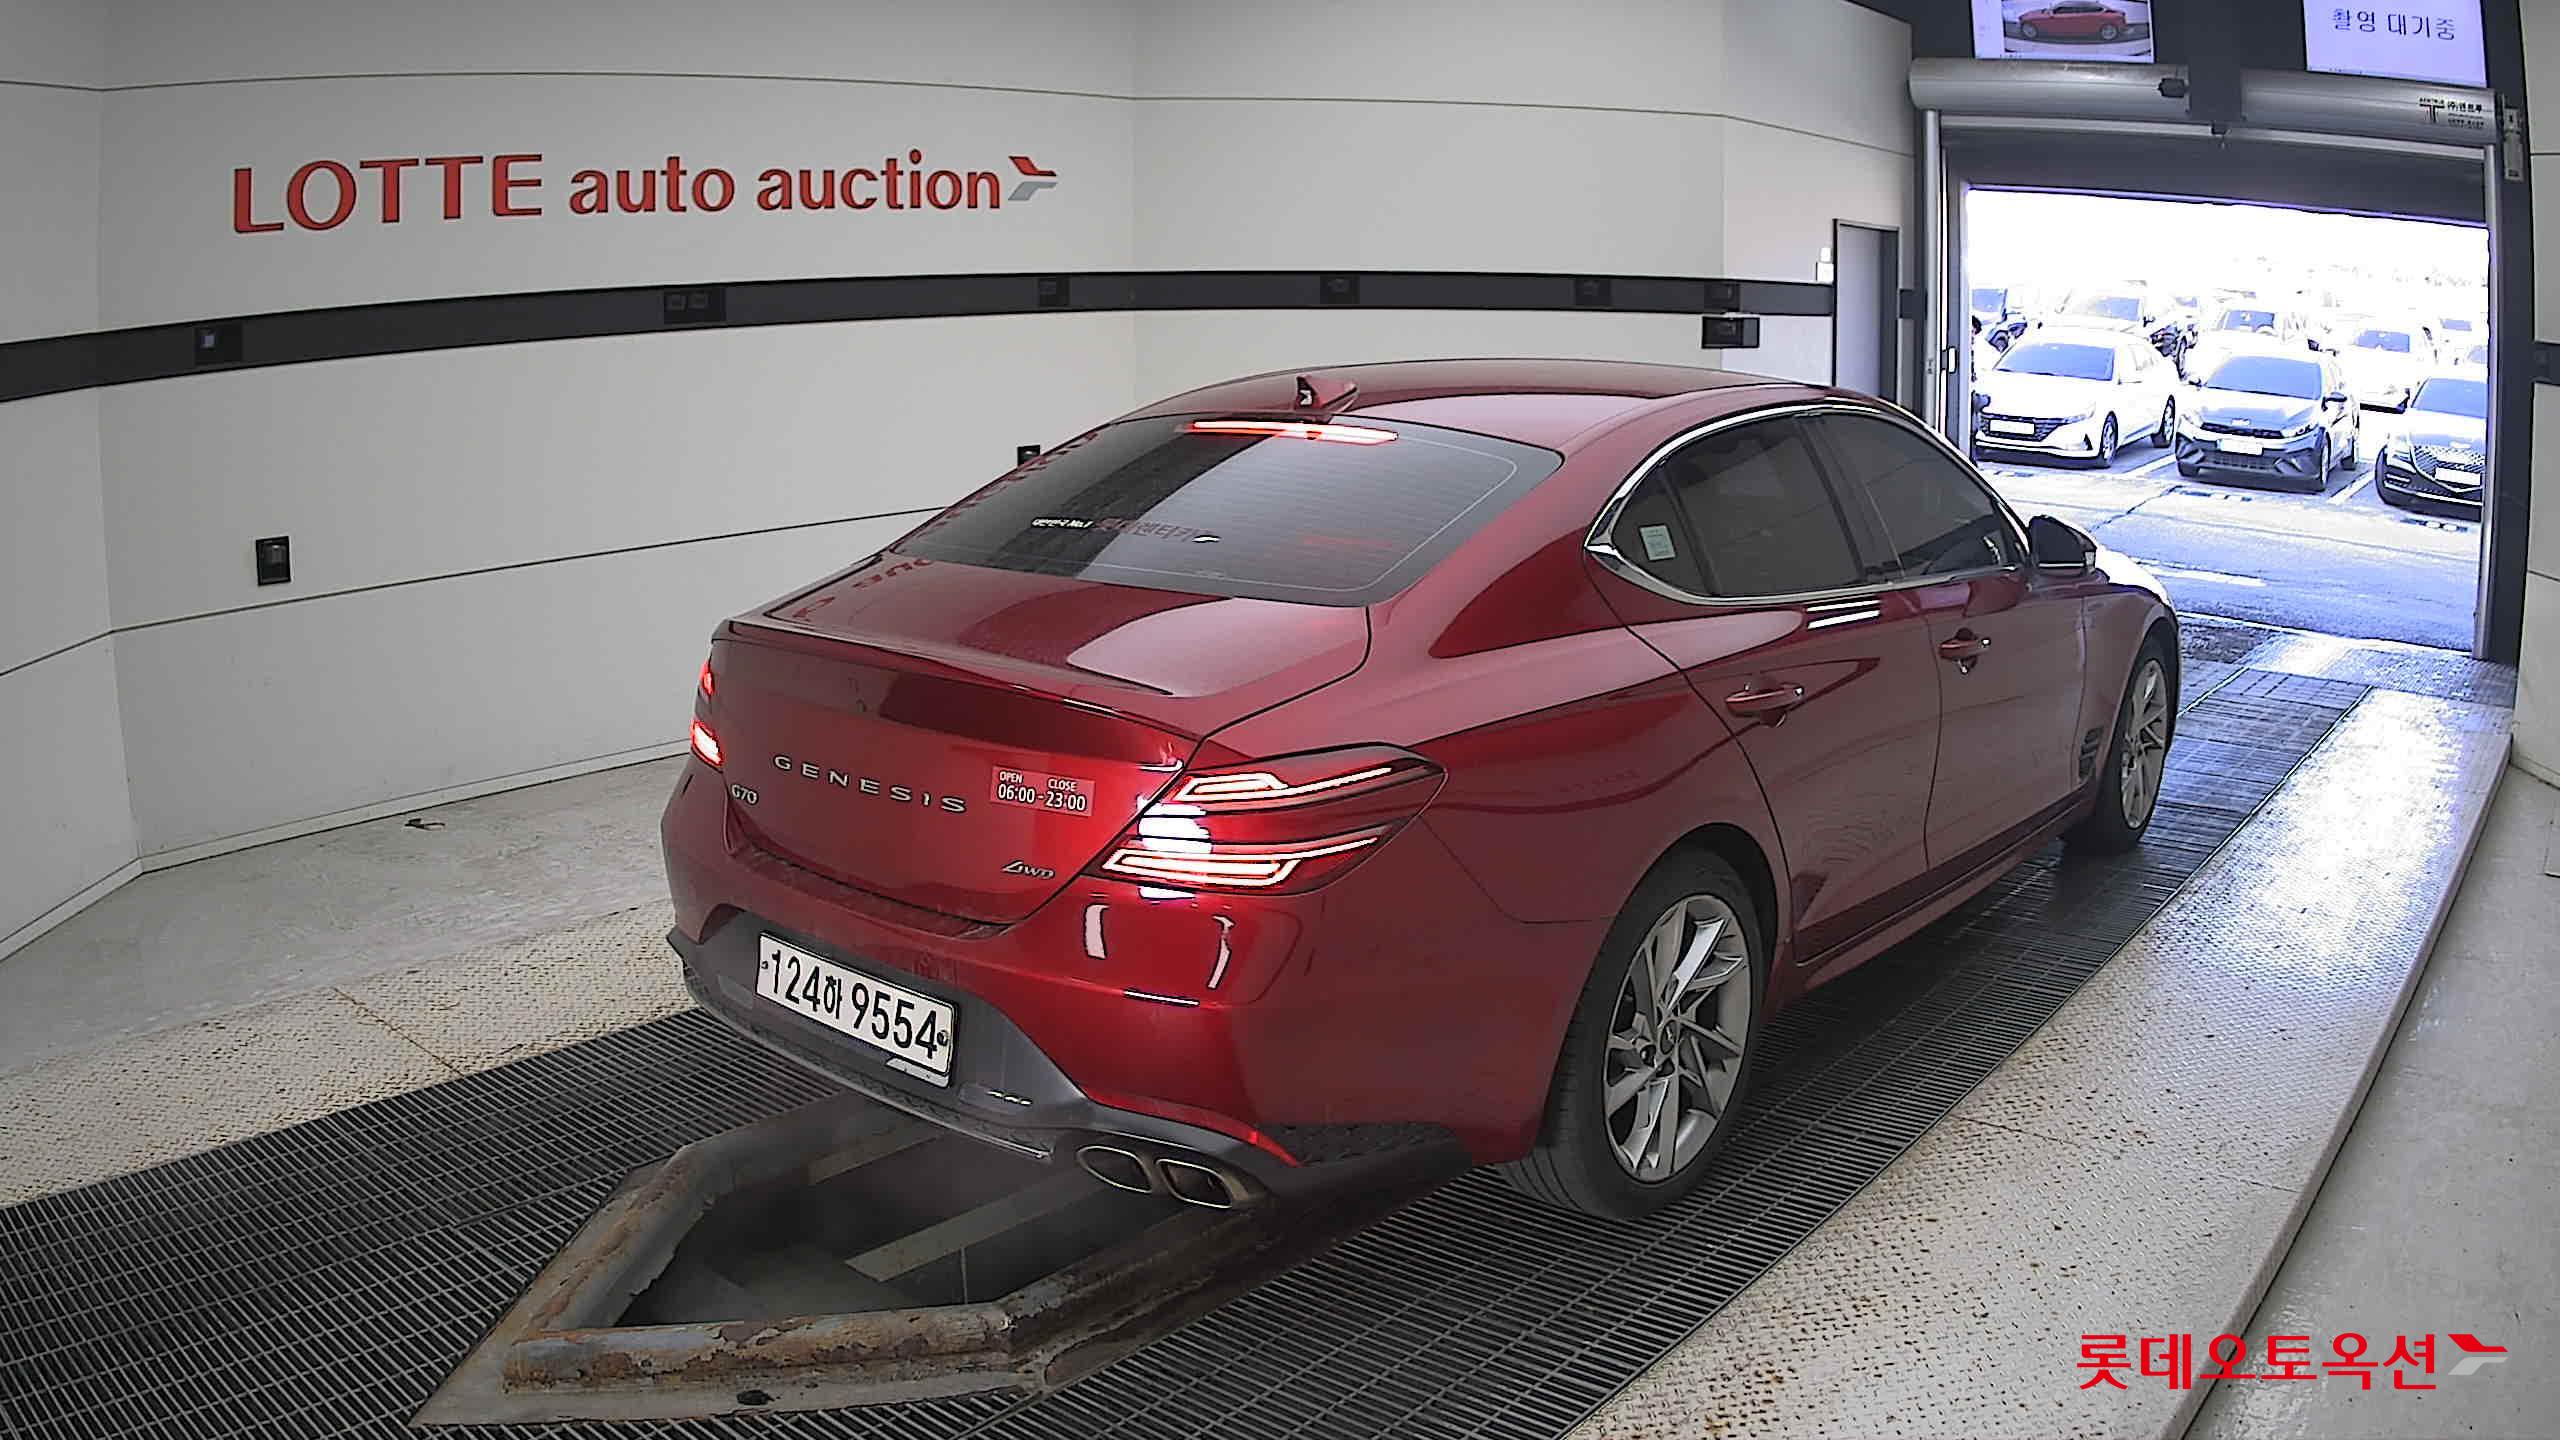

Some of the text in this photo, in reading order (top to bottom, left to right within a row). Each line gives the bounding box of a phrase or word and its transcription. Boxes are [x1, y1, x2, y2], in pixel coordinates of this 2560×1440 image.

[2387, 13, 2456, 41] 대기중
[234, 149, 1001, 233] LOTTE auto auction
[730, 784, 759, 805] G70
[773, 755, 967, 813] GENESIS
[999, 771, 1078, 792] OPEN CLOSE
[851, 982, 938, 1060] 9554
